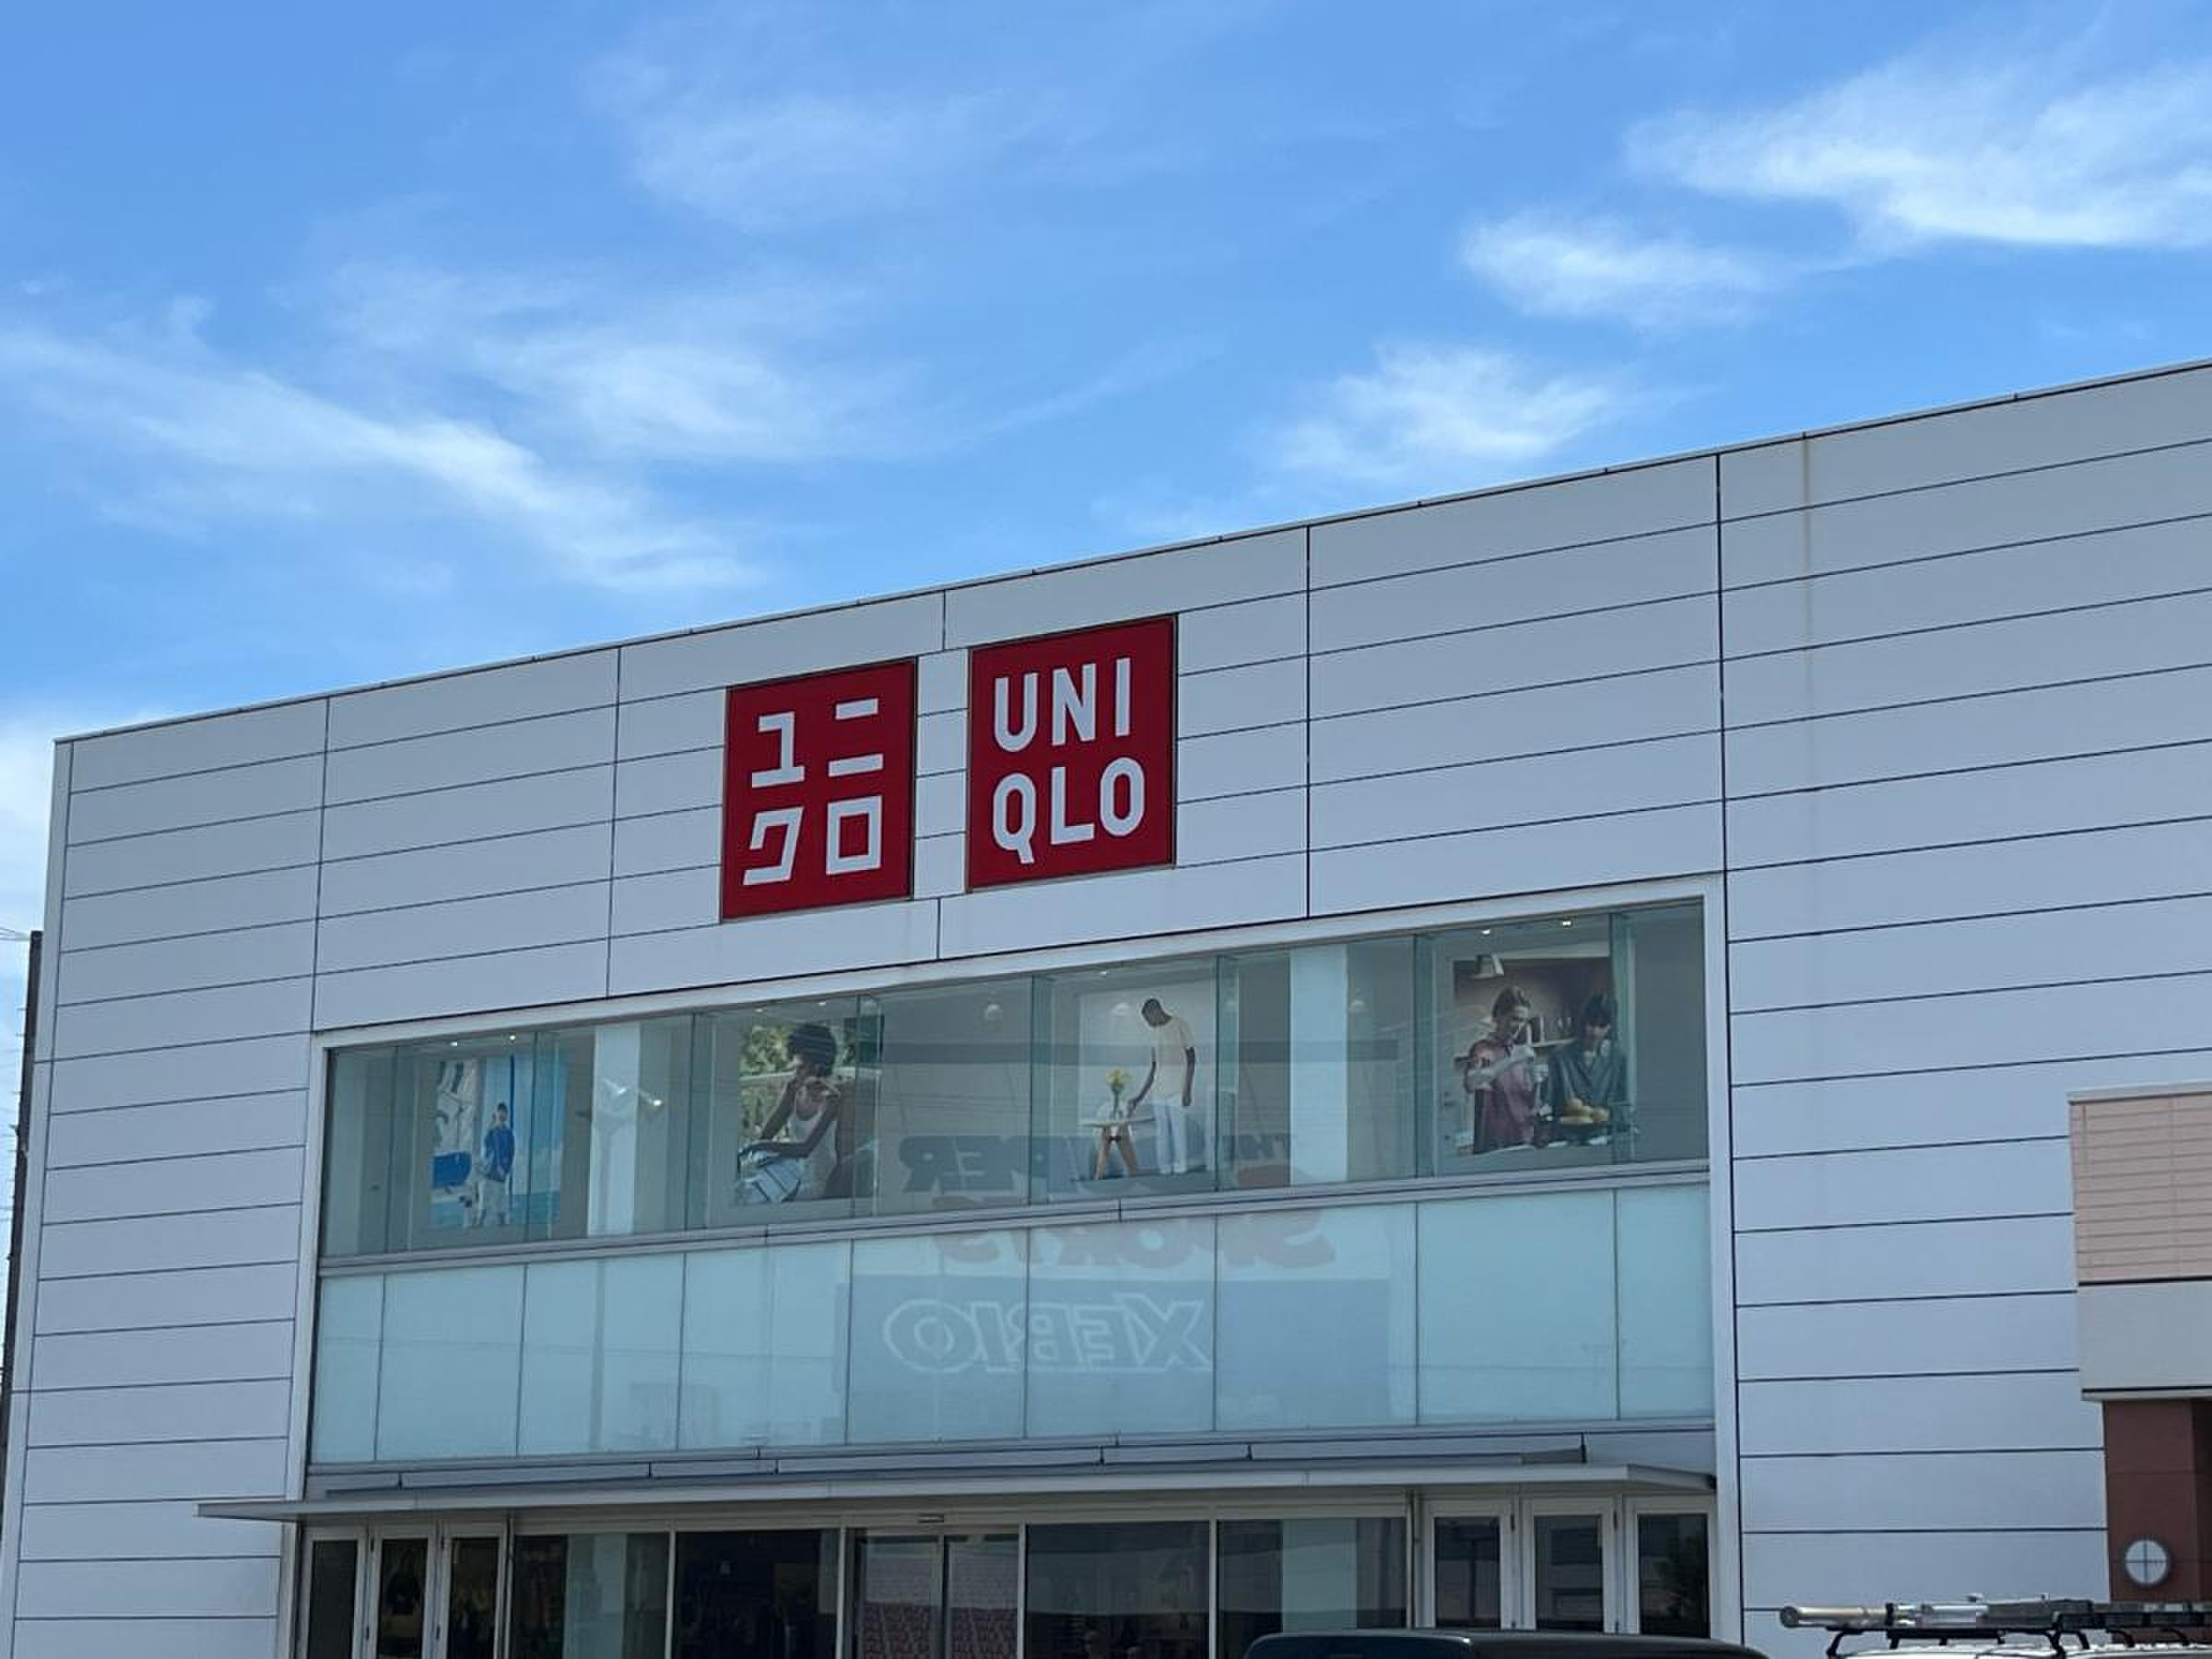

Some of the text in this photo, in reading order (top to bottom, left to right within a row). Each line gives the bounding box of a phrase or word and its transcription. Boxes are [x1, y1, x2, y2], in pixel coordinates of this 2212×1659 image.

[750, 698, 884, 789] ユニ
[994, 656, 1132, 753] UNI
[742, 794, 884, 887] クロ
[992, 757, 1146, 865] QLO
